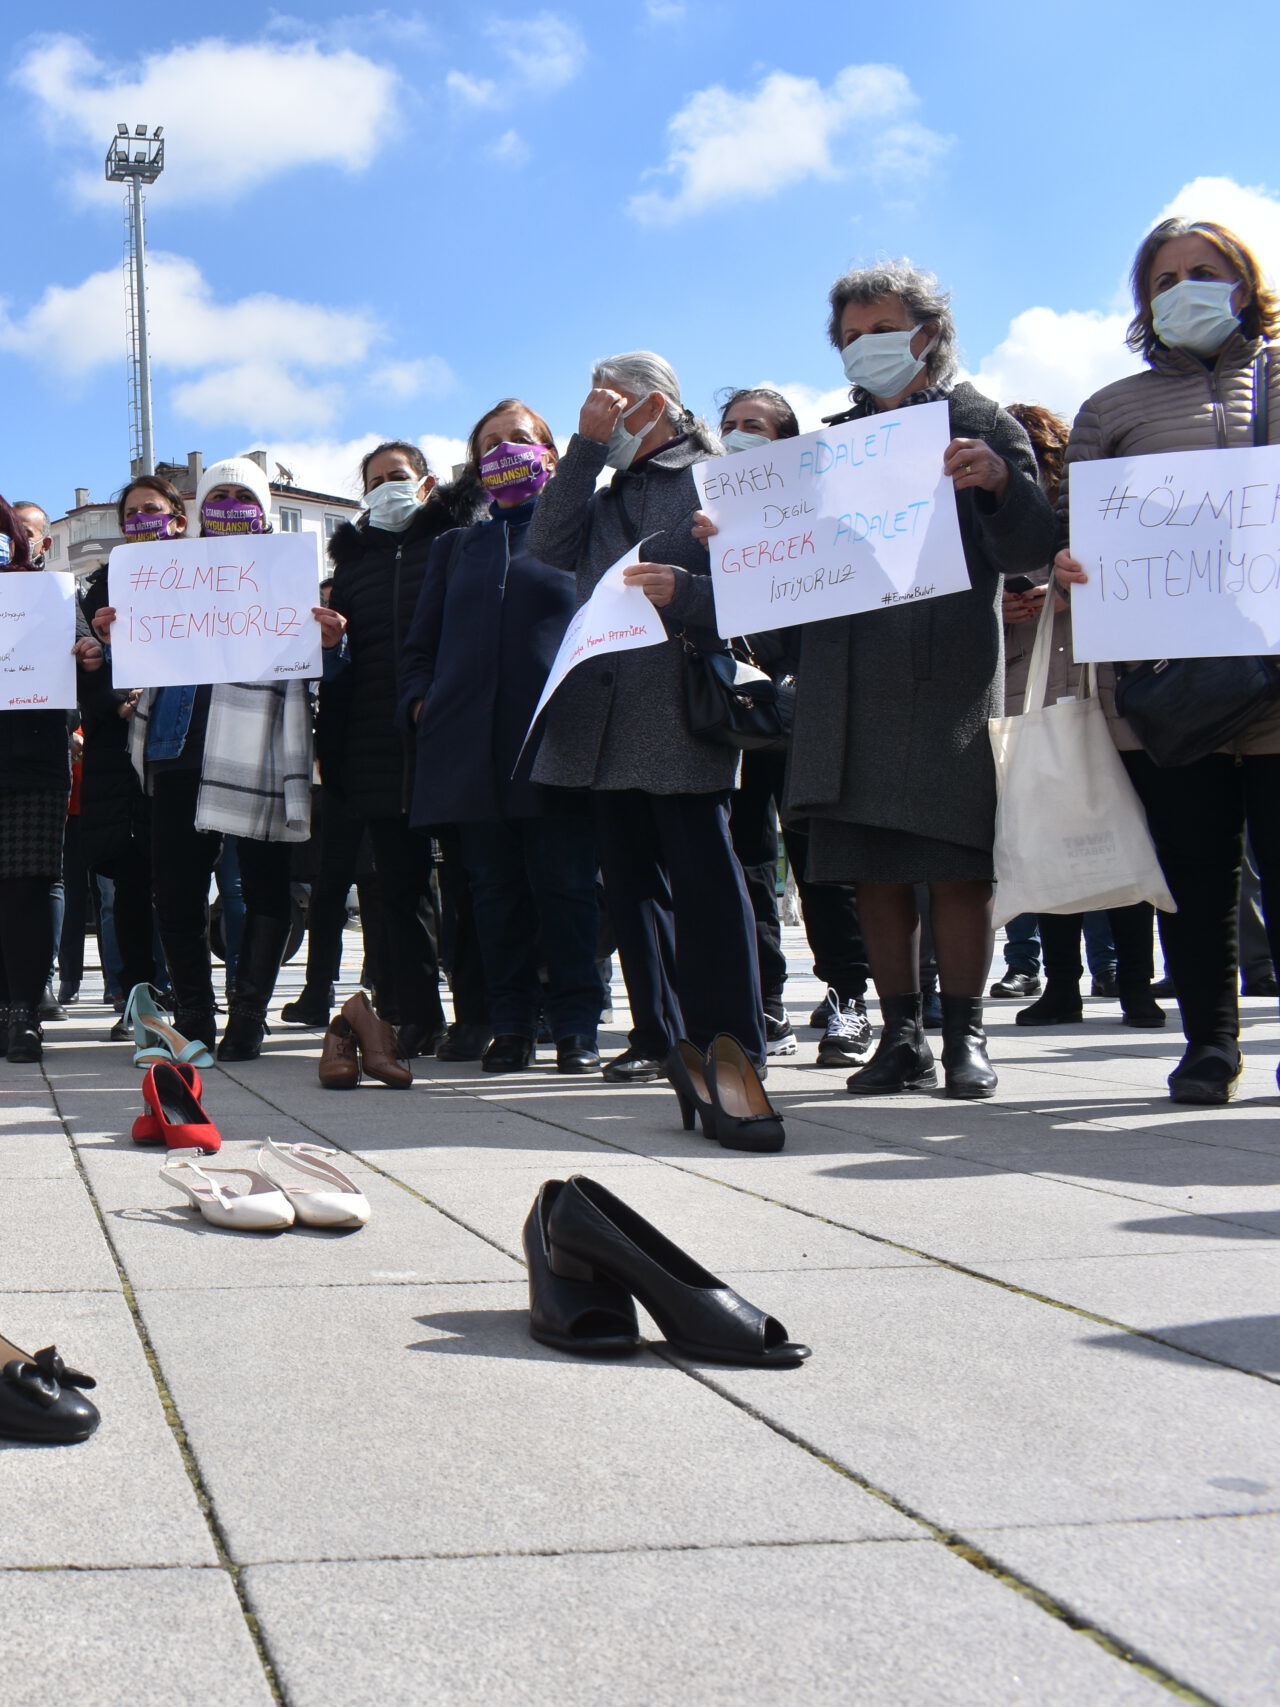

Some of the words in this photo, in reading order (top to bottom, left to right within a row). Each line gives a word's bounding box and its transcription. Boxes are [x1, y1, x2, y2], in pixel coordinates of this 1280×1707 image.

[703, 462, 784, 500] ERKEK
[799, 422, 902, 479] ADALET
[833, 501, 930, 546] ADALET
[130, 559, 259, 592] #ÖLMEK
[1098, 540, 1280, 602] İSTEMİYO
[129, 605, 301, 642] İSTEMİYORUZ
[608, 624, 647, 641] ATATÜRK
